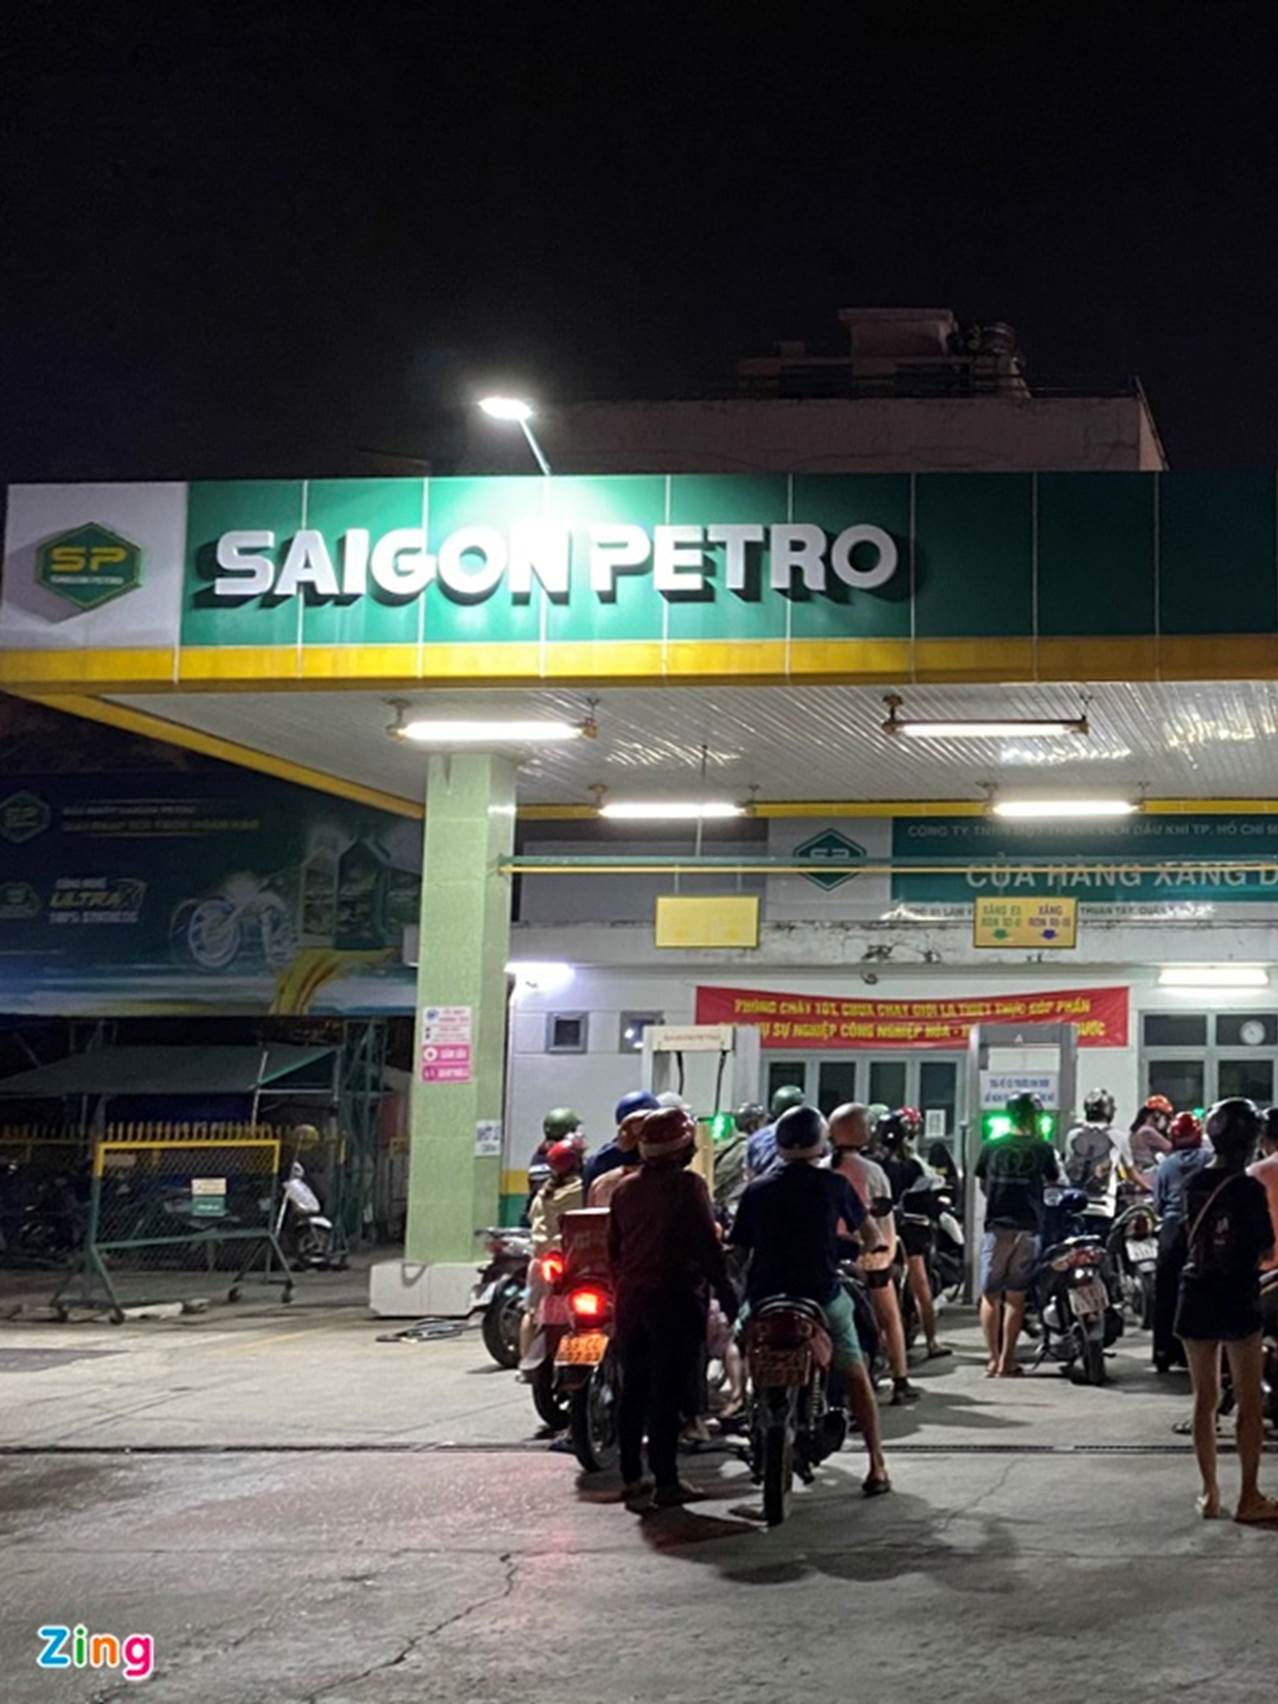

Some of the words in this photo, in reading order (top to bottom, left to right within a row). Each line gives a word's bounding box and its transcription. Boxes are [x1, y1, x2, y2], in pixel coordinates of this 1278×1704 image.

[51, 546, 127, 572] SP
[214, 525, 572, 595] SAIGON
[589, 522, 899, 594] PETRO
